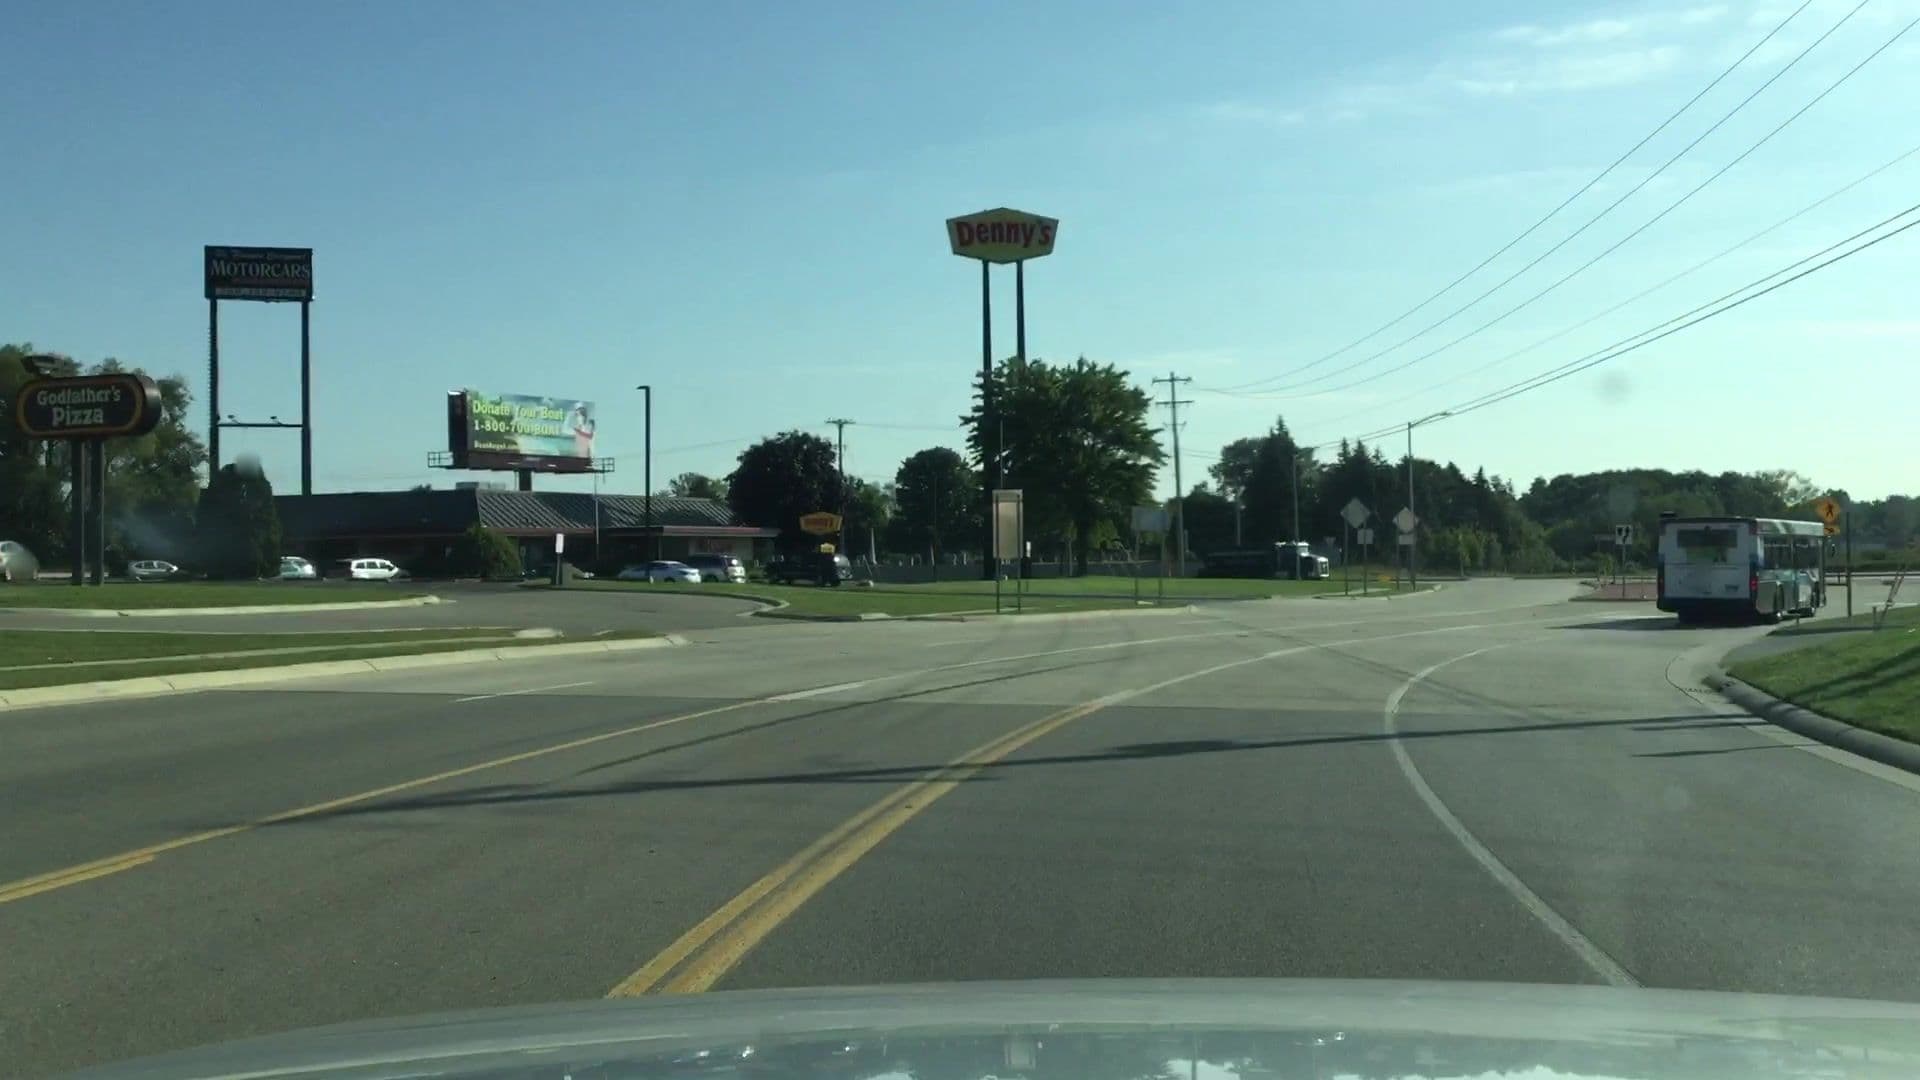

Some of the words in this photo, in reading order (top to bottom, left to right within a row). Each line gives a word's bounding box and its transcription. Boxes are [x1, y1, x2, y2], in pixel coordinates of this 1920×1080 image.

[955, 220, 1052, 248] Denny's
[208, 259, 311, 280] MOTORCARS
[36, 386, 121, 406] Godfather's
[51, 405, 104, 428] Pizza
[472, 399, 510, 416] Donate
[514, 405, 538, 419] Your
